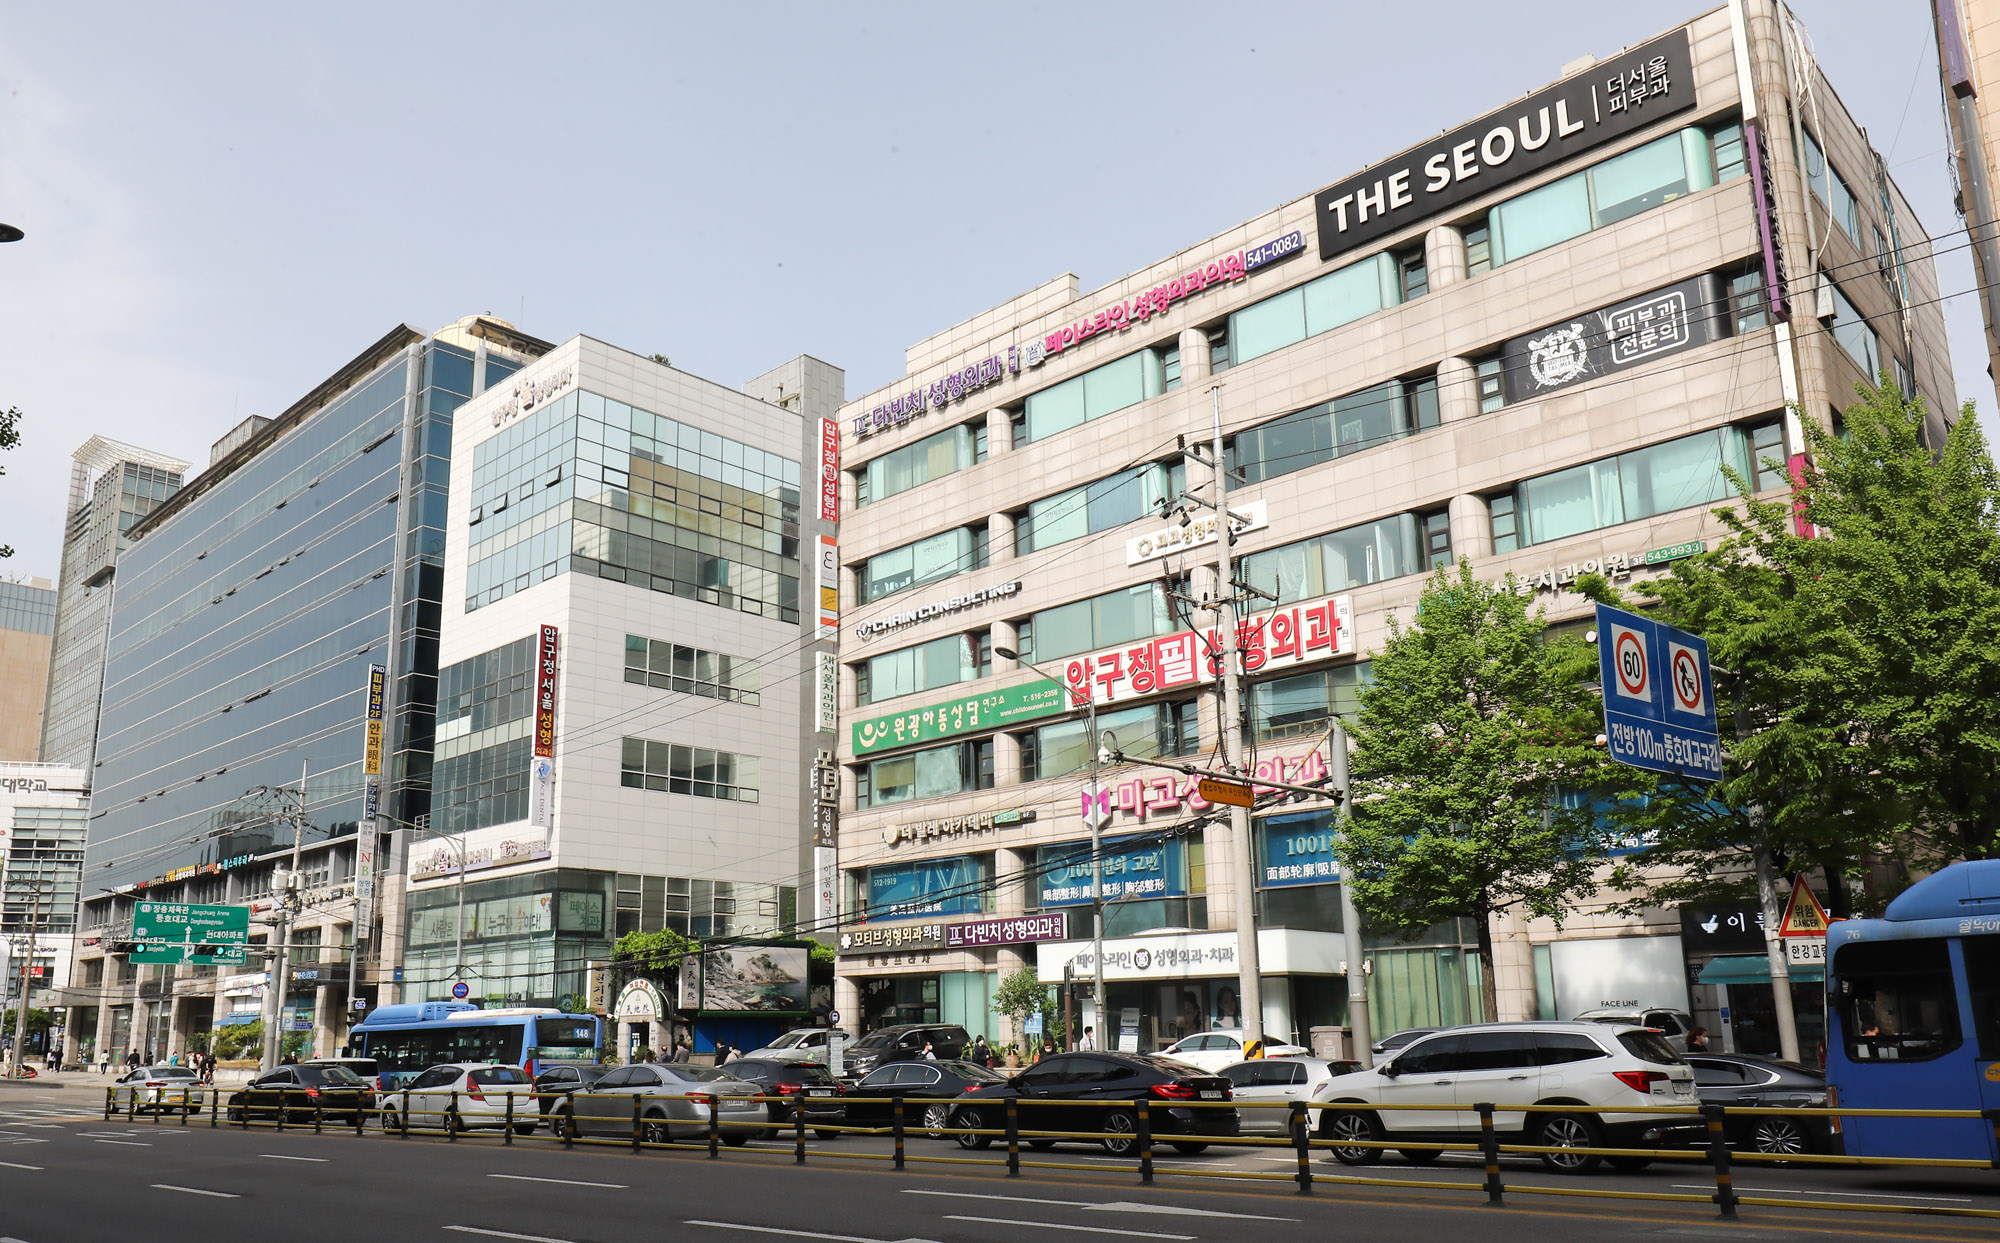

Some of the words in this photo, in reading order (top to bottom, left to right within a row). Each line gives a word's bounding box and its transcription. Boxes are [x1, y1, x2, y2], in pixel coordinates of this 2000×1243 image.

[1607, 55, 1668, 94] 더서울
[1609, 75, 1671, 113] 피부과
[1328, 168, 1413, 233] THE
[1424, 98, 1584, 193] SEOUL
[1045, 300, 1130, 352] 페이스라인
[1132, 251, 1245, 320] 성형외과의원
[1247, 233, 1299, 268] 541-0082
[1616, 299, 1677, 332] 피부과
[1619, 323, 1679, 356] 전문의
[872, 389, 922, 425] 다빈치
[928, 355, 1002, 407] 성형외과
[1632, 557, 1645, 565] 3F
[1647, 543, 1699, 562] 543-9933
[872, 609, 917, 632] CHAIN
[918, 580, 1017, 618] CONSULTING
[372, 665, 385, 673] PHD
[1624, 651, 1639, 680] 60
[372, 673, 382, 705] 피부과
[822, 654, 835, 722] 새서울치과의원
[983, 695, 1005, 714] 연구소
[1030, 688, 1058, 702] 516-2356
[1000, 701, 1059, 717] www.childcounsel.co.kr
[370, 709, 381, 718] 2F
[369, 723, 380, 748] 안과
[1612, 723, 1635, 756] 전방
[1636, 727, 1664, 762] 100m
[1664, 733, 1719, 772] 동호대교구간
[367, 750, 378, 772] 眼科
[0, 777, 47, 793] 대학교
[1117, 751, 1327, 817] 미고성외과
[821, 808, 831, 837] 성형
[902, 823, 912, 840] 더
[917, 819, 940, 838] 발레
[942, 811, 993, 834] 아카데미
[1286, 834, 1337, 856] 1001
[1132, 851, 1160, 872] 고민
[153, 905, 189, 915] 장충체육관
[192, 909, 215, 917] Jangchung
[569, 901, 600, 914] 페이스
[1795, 904, 1814, 918] 위험
[156, 915, 188, 923] 동호대교
[431, 919, 453, 938] 사람은
[580, 916, 600, 929] 치과
[1054, 917, 1061, 936] 의원
[1793, 919, 1819, 928] DANGER
[206, 931, 244, 939] 현대아파트
[1846, 930, 1860, 940] 76
[575, 1029, 589, 1038] 148
